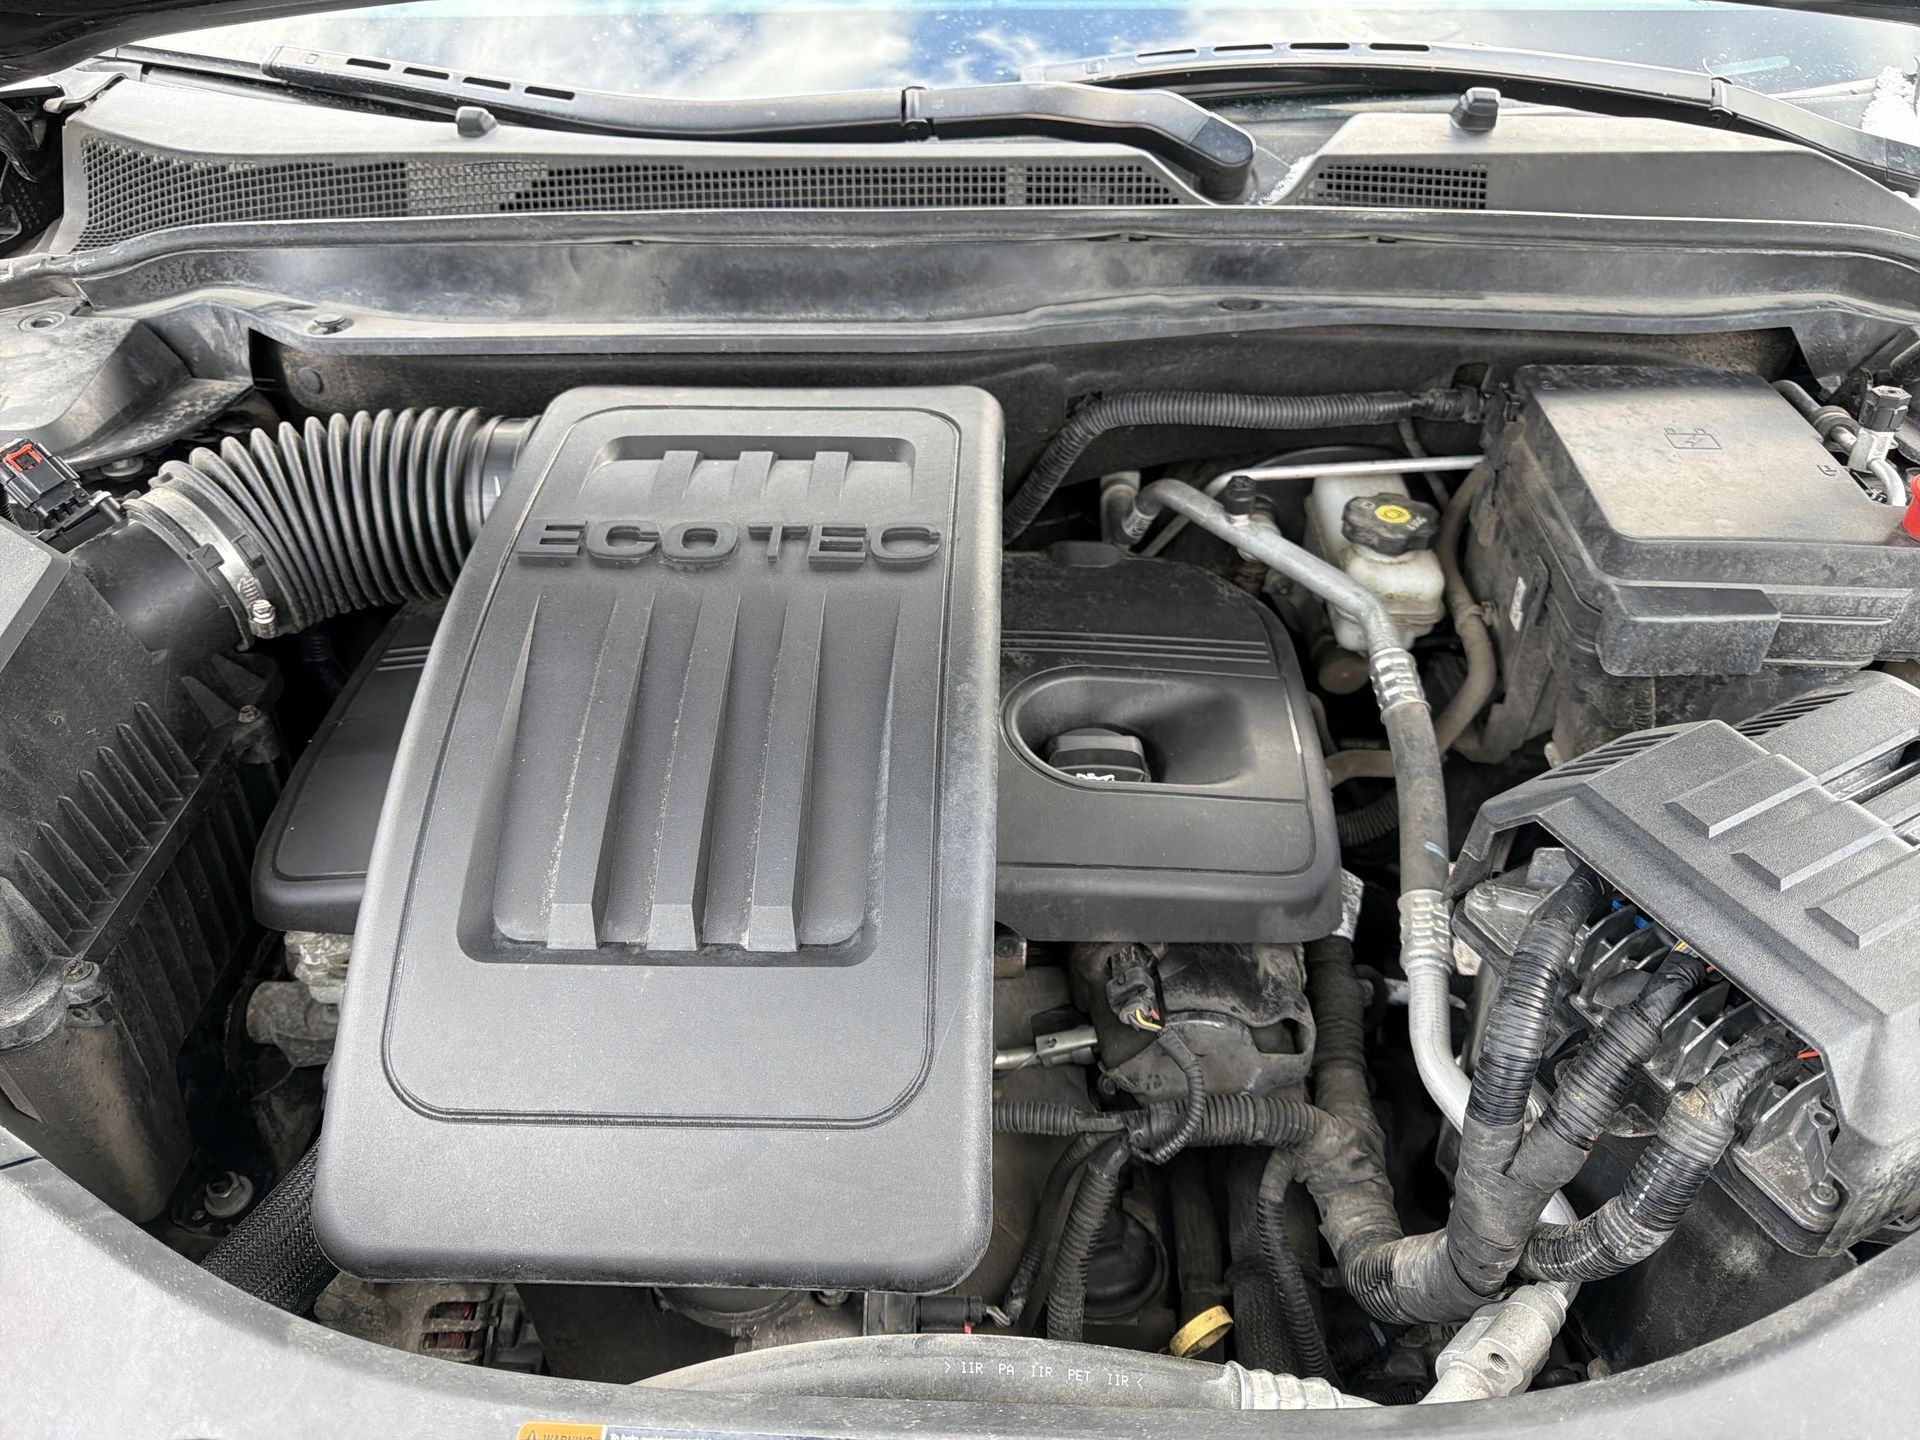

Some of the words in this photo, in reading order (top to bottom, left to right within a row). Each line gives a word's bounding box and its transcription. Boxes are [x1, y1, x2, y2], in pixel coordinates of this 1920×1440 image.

[516, 518, 942, 567] ECOTEC
[961, 1361, 984, 1374] IIR
[998, 1363, 1015, 1376] PA
[1030, 1365, 1054, 1379] IIR
[1068, 1368, 1091, 1382] PET
